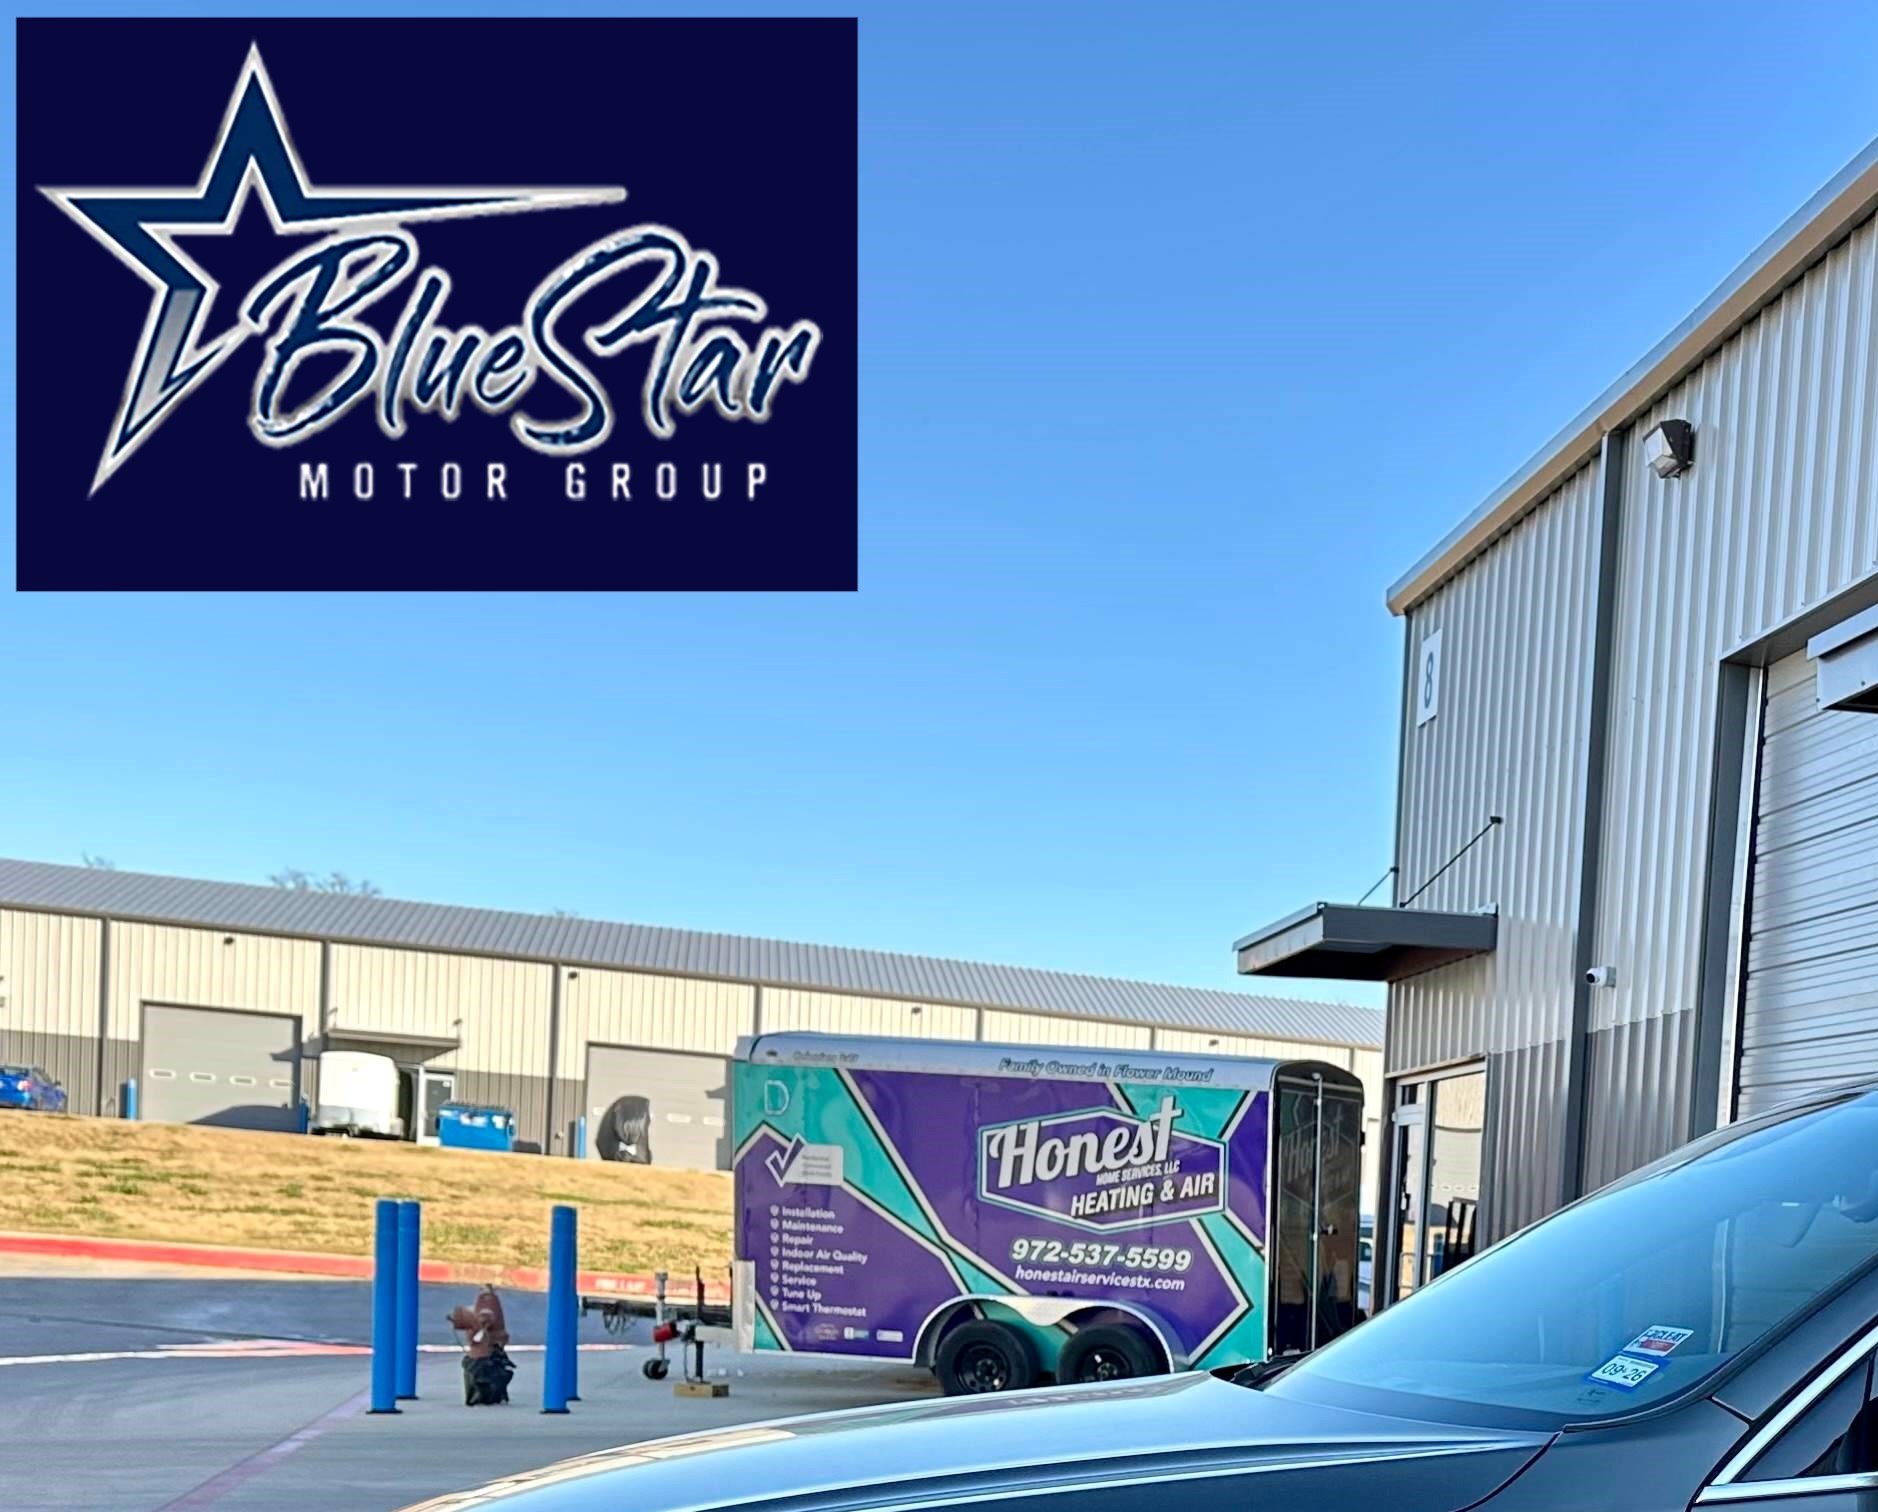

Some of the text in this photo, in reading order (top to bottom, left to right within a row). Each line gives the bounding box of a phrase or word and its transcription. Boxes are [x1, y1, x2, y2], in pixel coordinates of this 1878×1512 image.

[1424, 651, 1434, 709] 8
[999, 1057, 1214, 1082] Family Owned in Flower Mound
[989, 1096, 1184, 1188] Honest
[1164, 1159, 1181, 1175] LLC
[1071, 1172, 1215, 1217] HEATING & AIR
[782, 1206, 836, 1219] Installation
[782, 1220, 844, 1234] Maintenance
[782, 1233, 814, 1245] Repair
[782, 1247, 868, 1265] Indoor Air Quality
[1012, 1238, 1192, 1272] 972-537-5599
[782, 1260, 844, 1275] Replacement
[782, 1274, 817, 1287] Service
[1015, 1265, 1185, 1291] honestairservicestx.com
[782, 1287, 822, 1302] Tune Up
[782, 1300, 867, 1317] Smart Thermostat
[1623, 1368, 1647, 1382] 26
